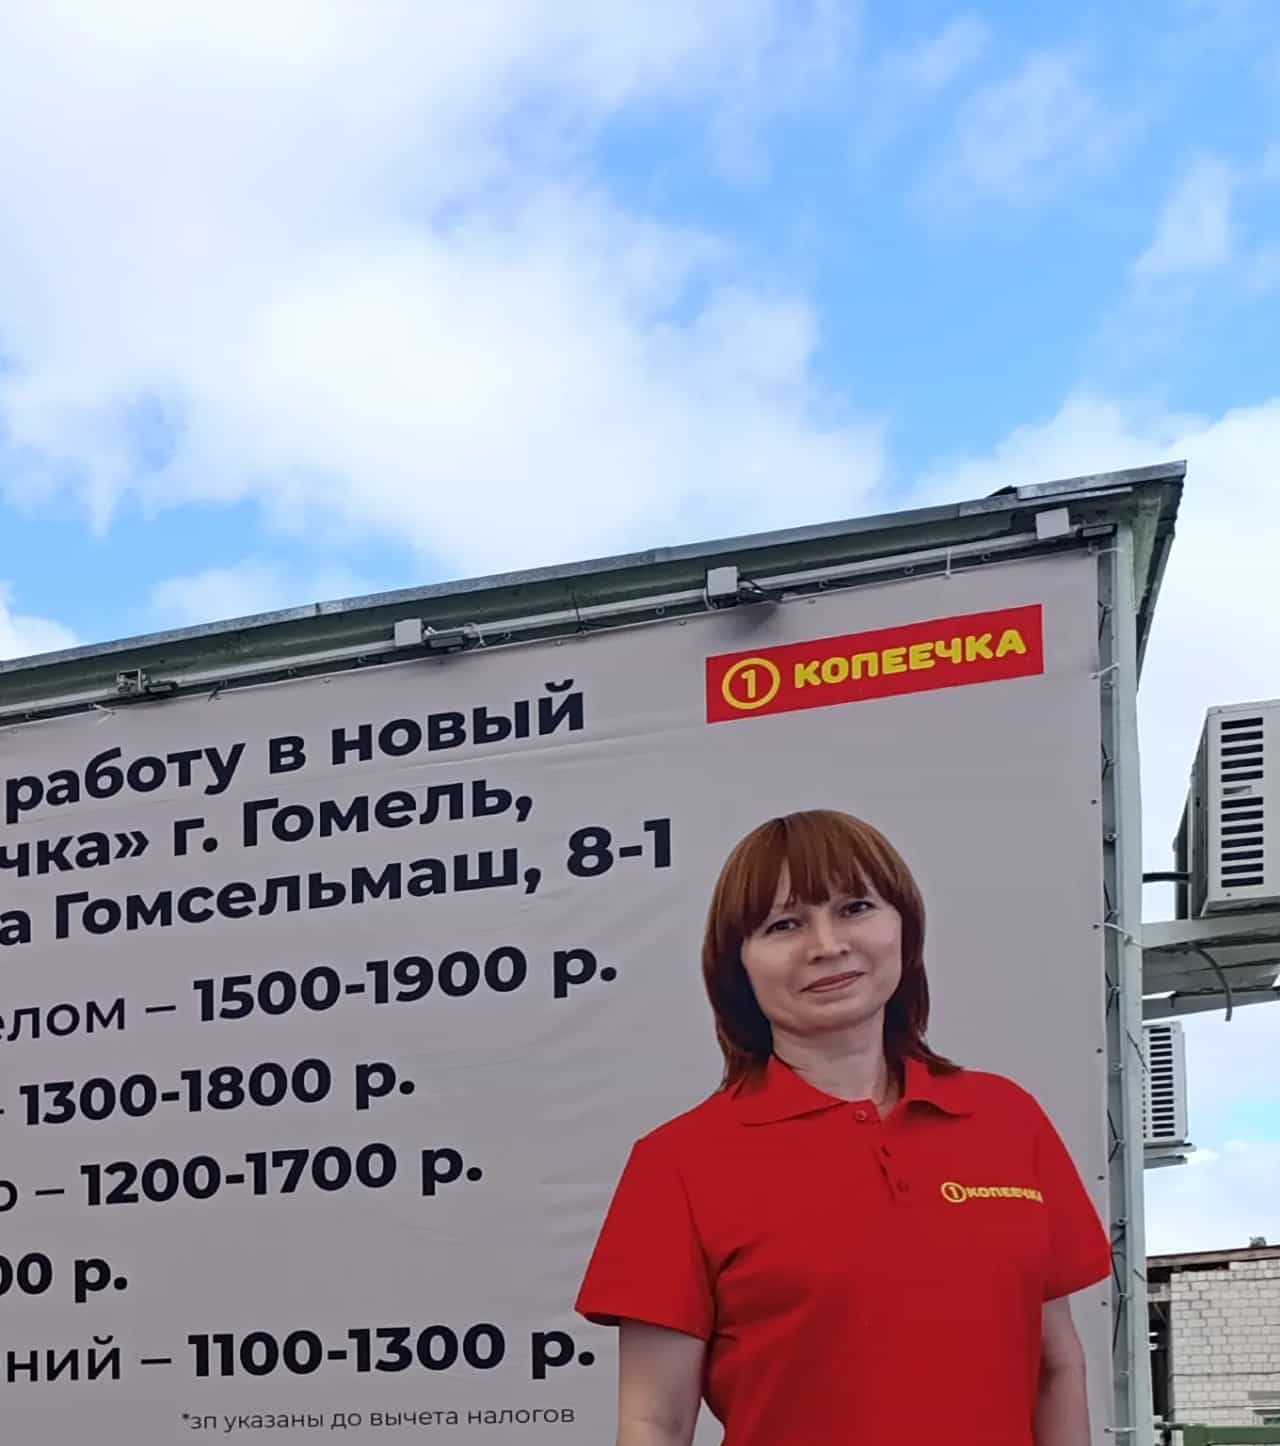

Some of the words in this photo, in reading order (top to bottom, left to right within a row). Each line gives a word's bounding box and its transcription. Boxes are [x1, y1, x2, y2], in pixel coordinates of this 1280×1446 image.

[794, 629, 1027, 689] КОПЕЕЧКА
[5, 742, 246, 824] работу
[268, 735, 307, 775] в
[331, 678, 584, 766] новый
[173, 817, 218, 857] г.
[243, 779, 533, 848] Гомель,
[55, 847, 542, 940] Гомсельмаш,
[566, 817, 671, 878] 8-1
[193, 946, 528, 1022] 1500-1900
[553, 948, 617, 999] р.
[19, 1058, 332, 1126] 1300-1800
[355, 1062, 415, 1111] р.
[80, 1142, 397, 1207] 1200-1700
[421, 1147, 483, 1197] р.
[74, 1258, 128, 1304] р.
[187, 1323, 506, 1377] 1100-1300
[531, 1330, 596, 1380] р.
[223, 1413, 324, 1434] указаны
[330, 1412, 363, 1431] до
[369, 1410, 459, 1427] вычета
[467, 1408, 575, 1425] налогов
